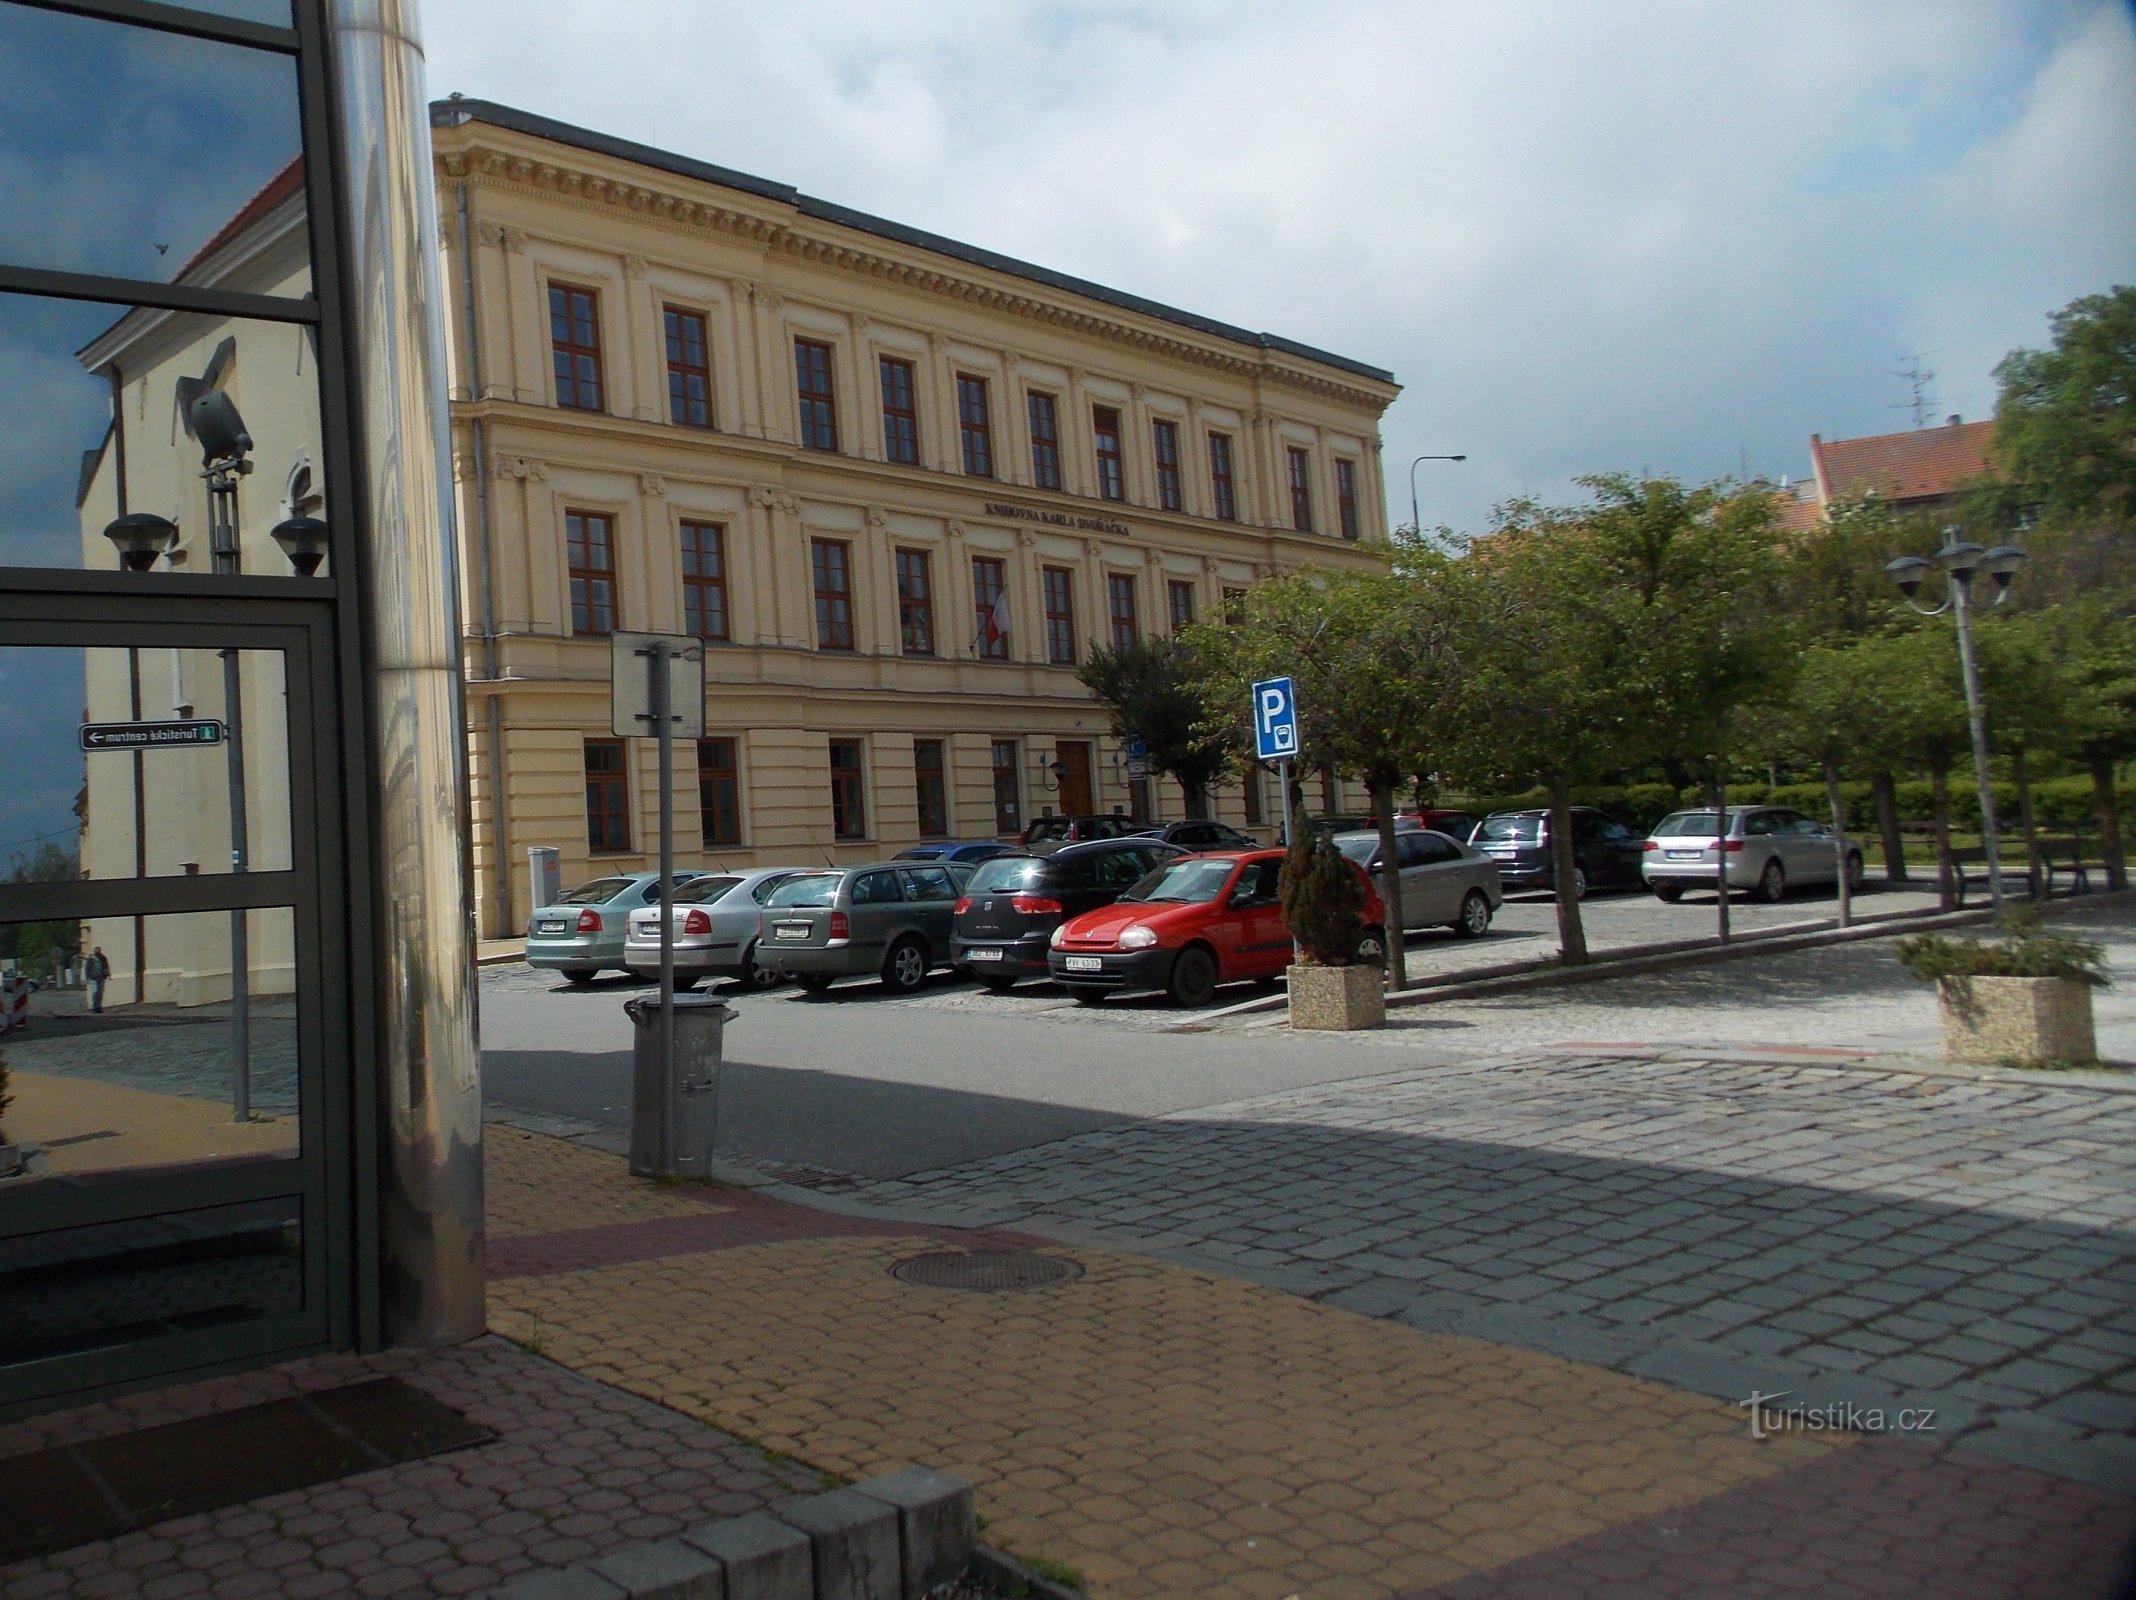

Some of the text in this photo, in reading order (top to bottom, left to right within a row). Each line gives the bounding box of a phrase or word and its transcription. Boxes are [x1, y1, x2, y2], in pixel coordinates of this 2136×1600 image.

[985, 502, 1040, 522] KNIHOVNA
[1041, 511, 1076, 528] KARLA
[1261, 688, 1285, 733] P
